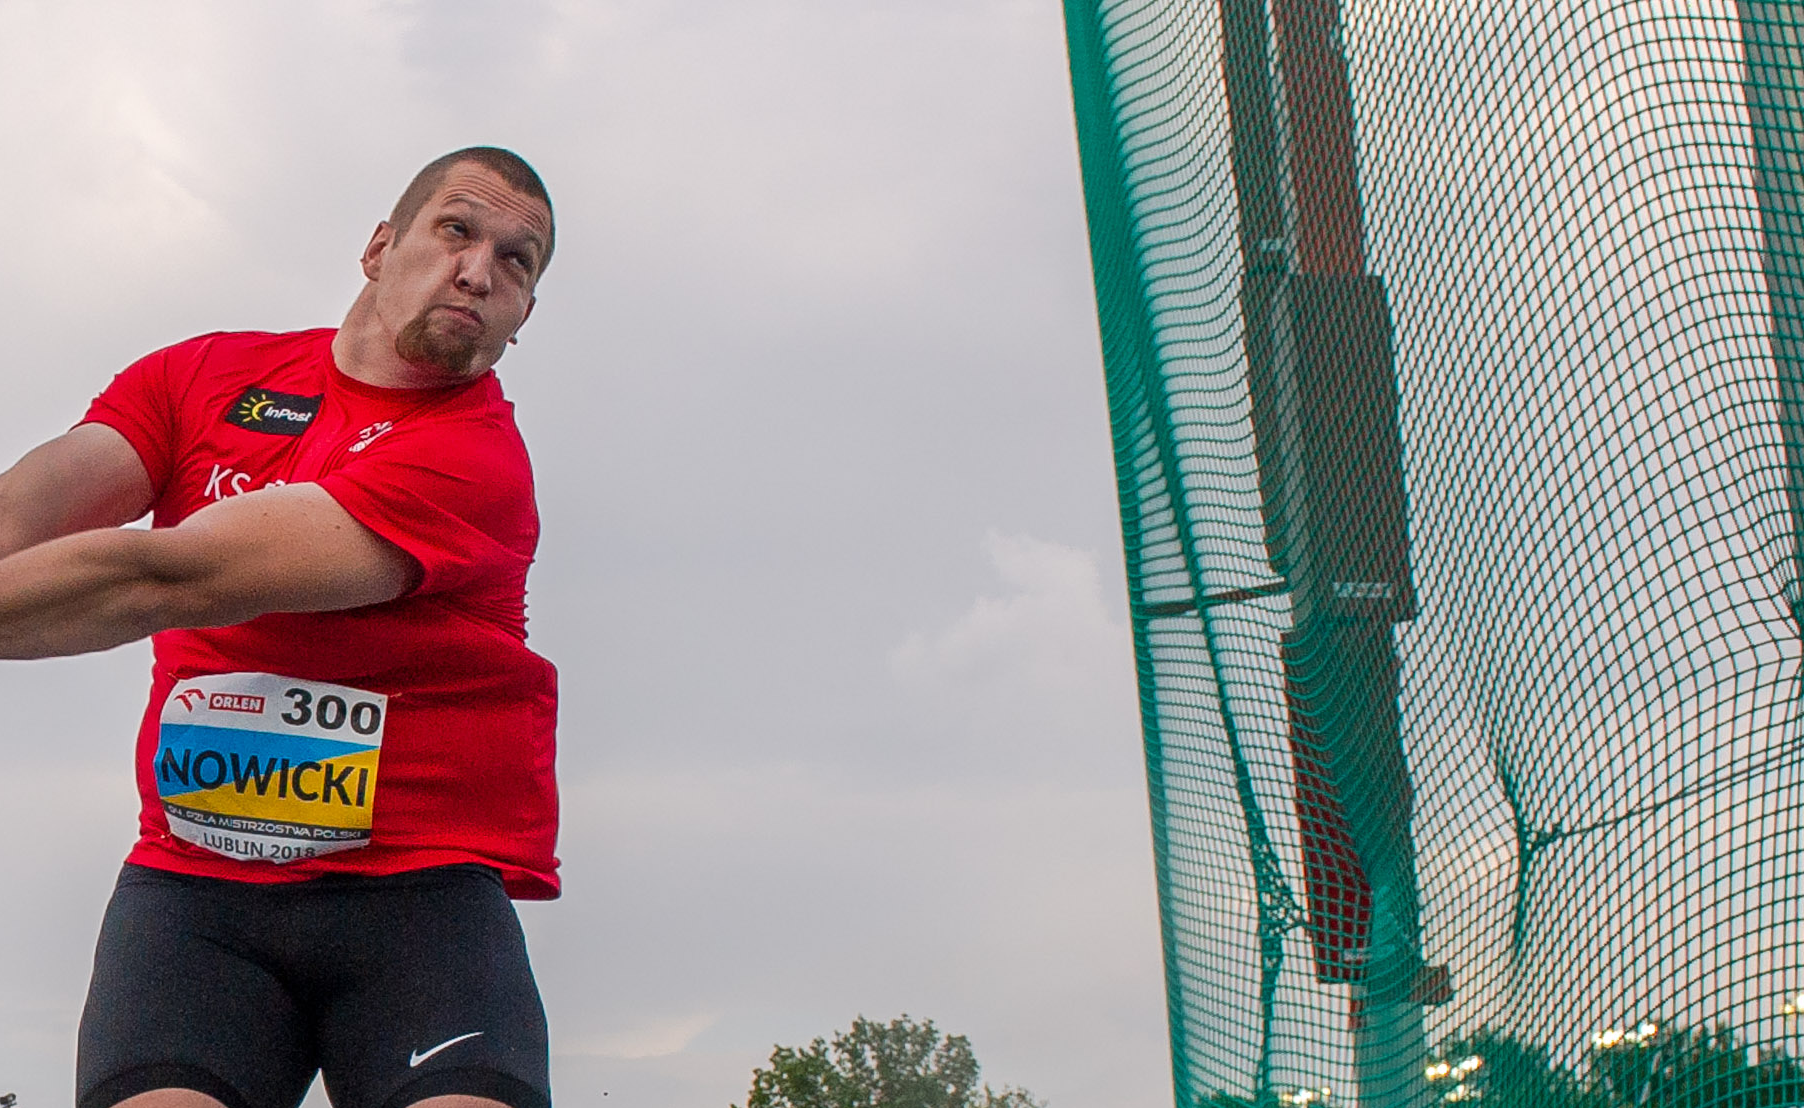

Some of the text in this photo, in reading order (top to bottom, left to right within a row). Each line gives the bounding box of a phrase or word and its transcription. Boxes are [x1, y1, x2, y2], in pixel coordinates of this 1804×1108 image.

[264, 405, 312, 423] InPost
[212, 694, 261, 711] ORLEN
[281, 687, 382, 735] 300
[161, 747, 369, 808] NOWICKI
[218, 817, 312, 837] MISTRZOSTWA
[312, 828, 361, 839] POLSKI
[203, 832, 316, 860] LUBLIN 2018
